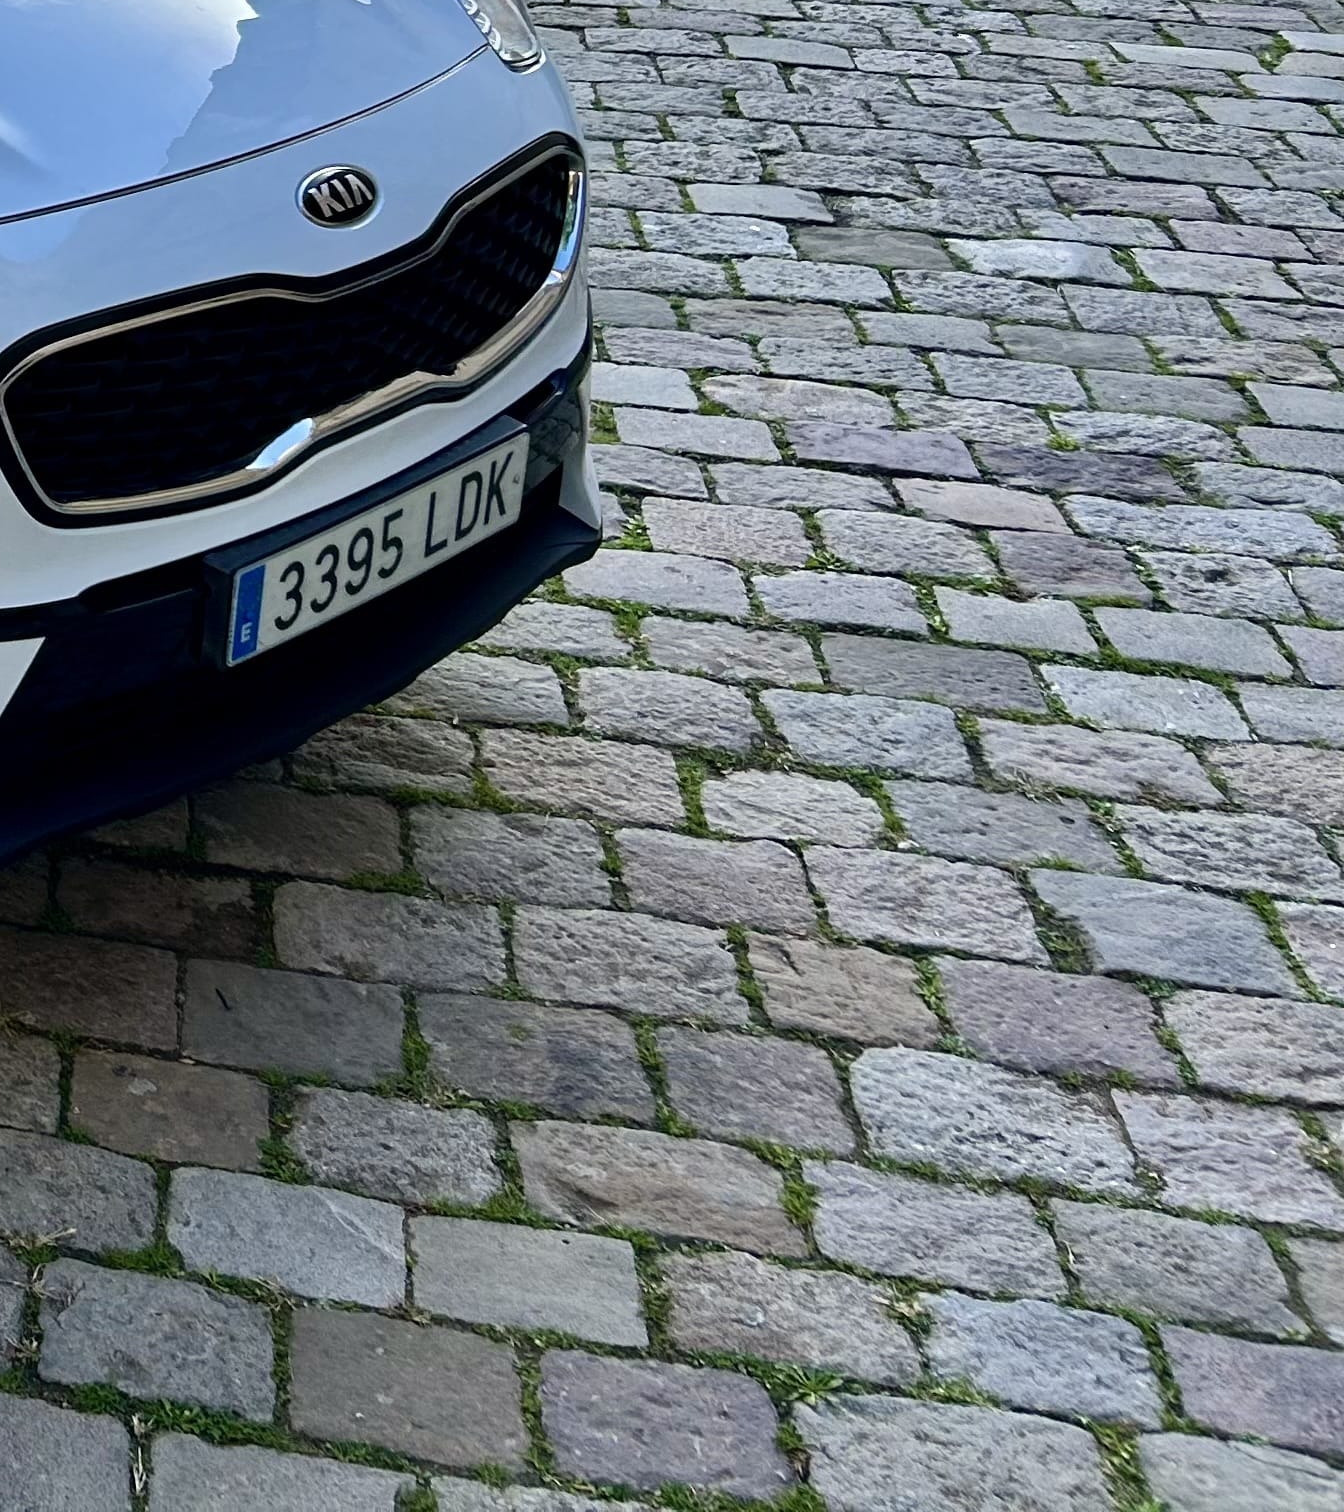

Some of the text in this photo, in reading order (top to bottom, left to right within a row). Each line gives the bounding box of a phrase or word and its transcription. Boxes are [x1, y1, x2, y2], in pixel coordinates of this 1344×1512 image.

[307, 174, 373, 218] KIA
[274, 450, 514, 631] 3395 LDK
[240, 621, 252, 643] E
